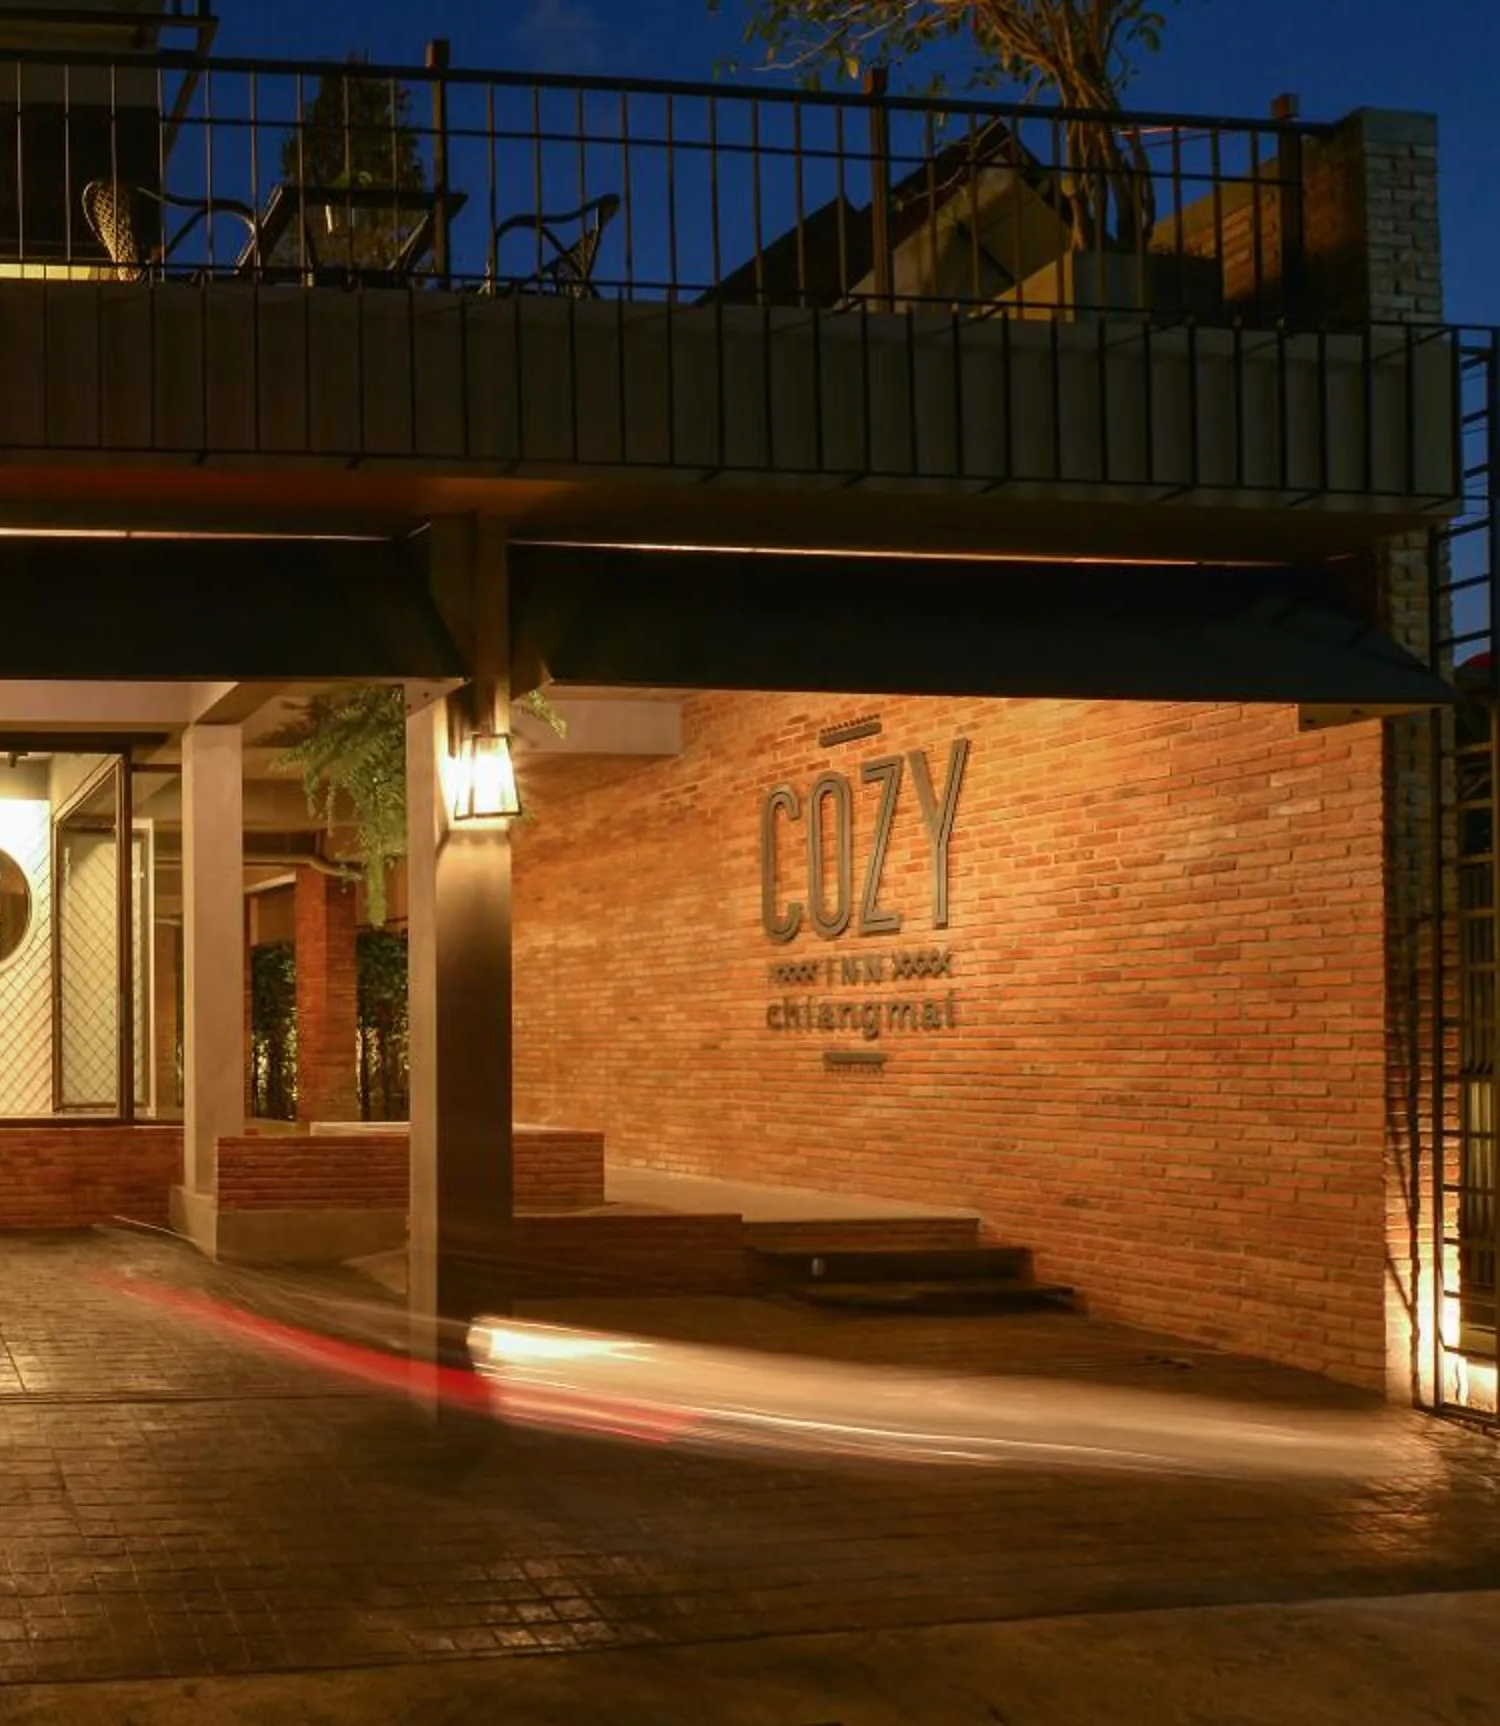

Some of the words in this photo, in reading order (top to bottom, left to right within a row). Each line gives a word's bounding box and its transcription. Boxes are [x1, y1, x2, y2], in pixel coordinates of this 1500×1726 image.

[762, 738, 970, 942] COZY
[826, 956, 882, 985] INN
[766, 988, 956, 1039] chiangmai
